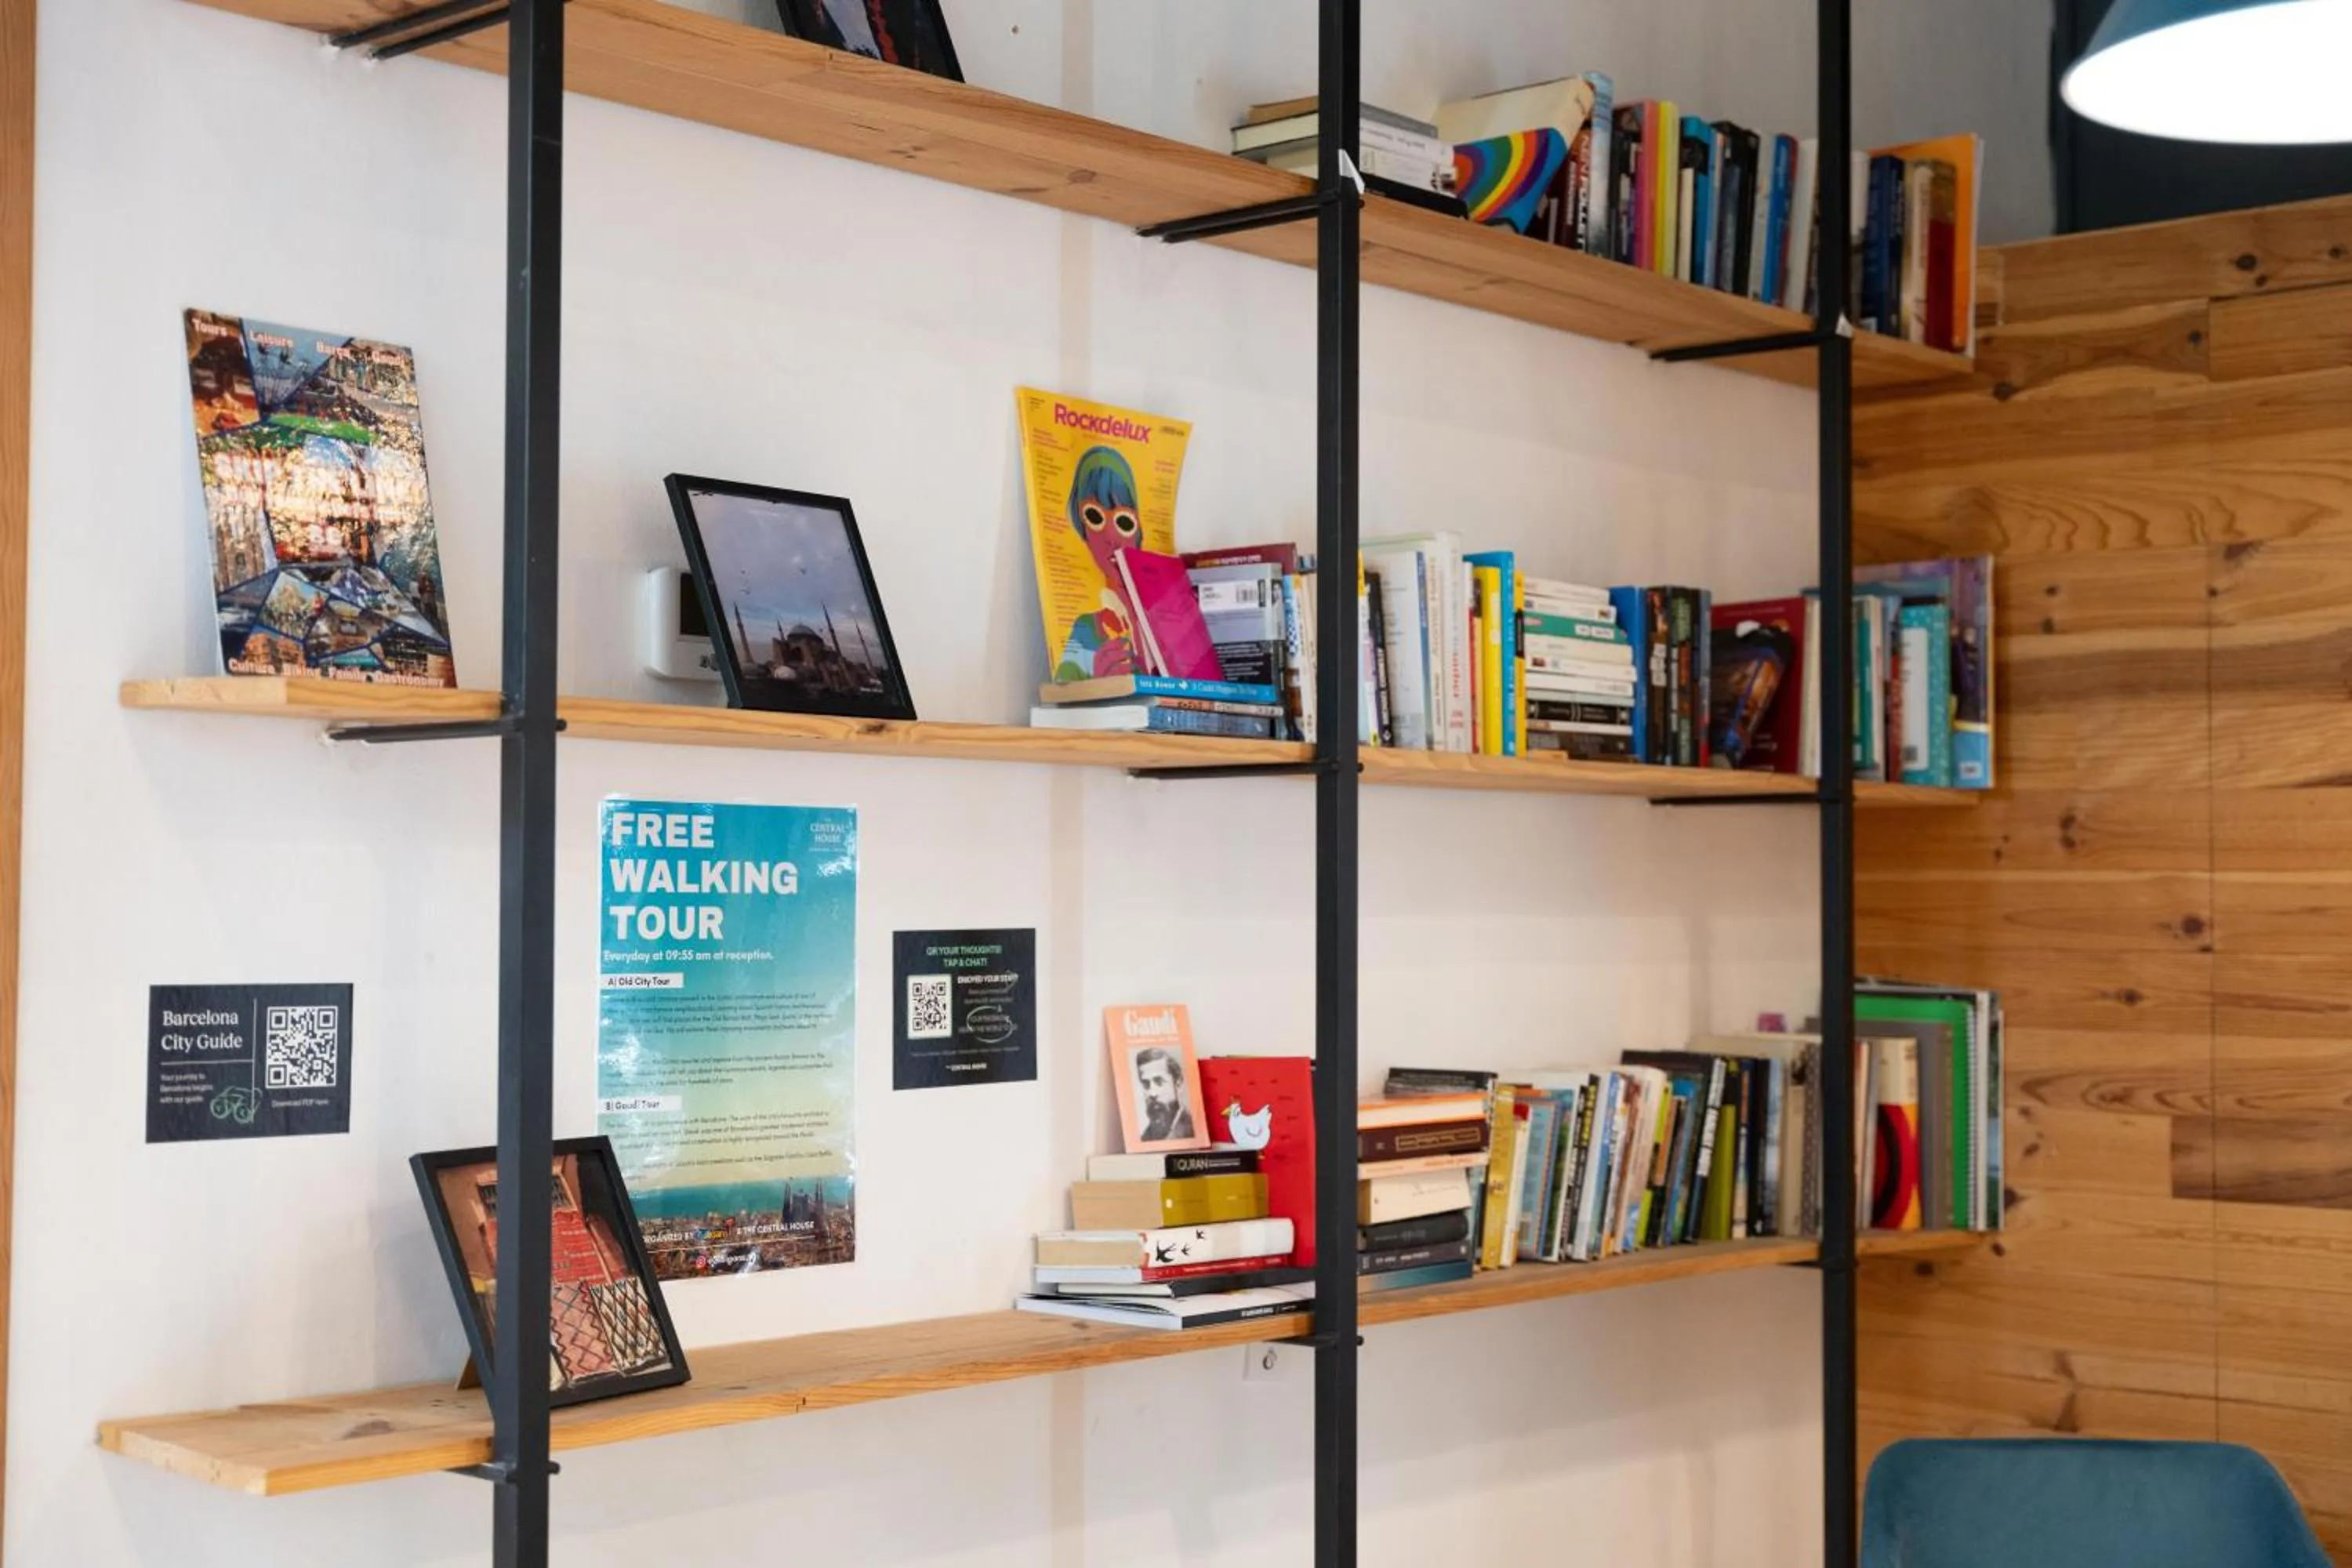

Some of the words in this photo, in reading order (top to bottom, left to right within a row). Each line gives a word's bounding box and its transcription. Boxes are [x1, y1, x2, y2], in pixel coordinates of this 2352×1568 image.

[1577, 174, 1589, 251] FOLLET
[191, 318, 228, 337] Tours
[249, 329, 294, 349] Leisure
[1053, 401, 1152, 444] Rockdelux
[228, 657, 275, 675] Culture
[611, 812, 716, 849] FREE
[610, 858, 799, 895] WALKING
[610, 906, 724, 941] TOUR
[603, 949, 650, 964] Everyday
[652, 950, 663, 961] at
[666, 949, 694, 961] 09:55
[695, 952, 711, 961] am
[713, 950, 724, 961] at
[943, 958, 957, 967] TAP
[959, 958, 964, 967] &
[965, 957, 988, 967] CHAT!
[619, 978, 633, 986] Old
[635, 976, 652, 989] City
[653, 976, 670, 986] Tour
[162, 1010, 240, 1027] Barcelona
[161, 1034, 194, 1054] City
[197, 1033, 244, 1050] Guide
[641, 1099, 660, 1109] Tour
[1177, 1158, 1208, 1171] QURAN
[789, 1221, 815, 1231] HOUSE
